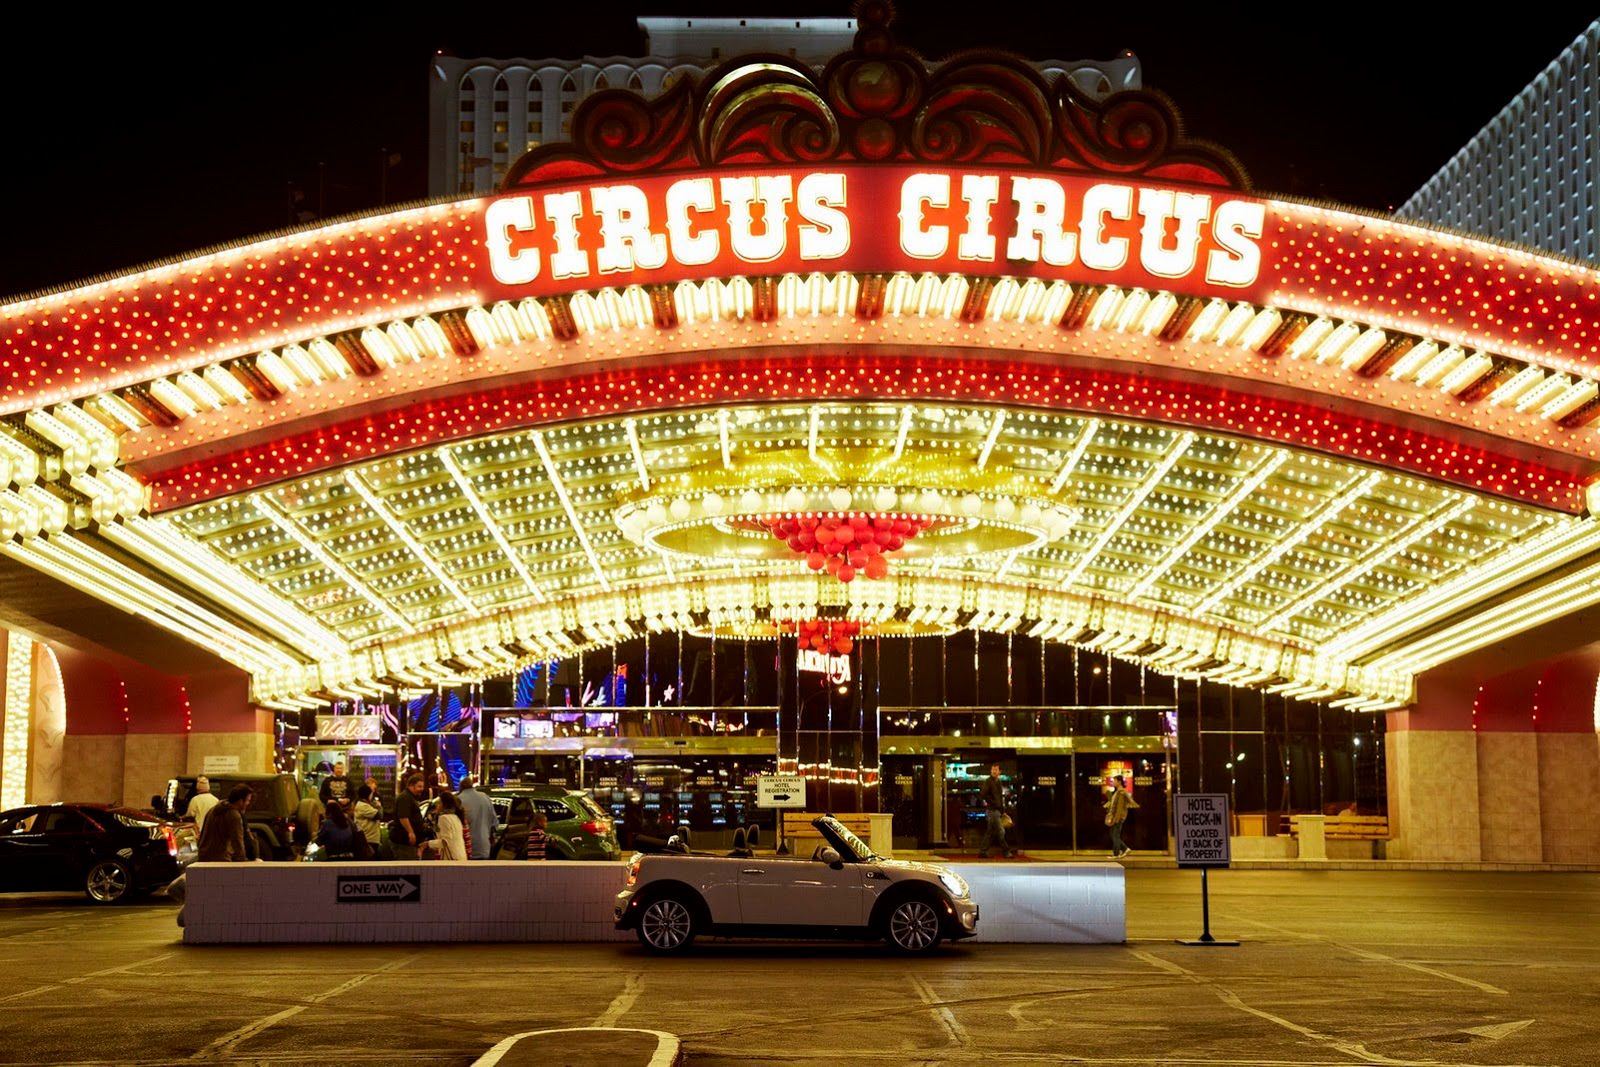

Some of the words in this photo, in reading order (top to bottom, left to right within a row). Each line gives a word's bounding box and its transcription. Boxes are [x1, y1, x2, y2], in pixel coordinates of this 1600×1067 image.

[485, 173, 851, 285] CIRCUS
[898, 173, 1267, 288] CIRCUS
[321, 719, 374, 737] Valet
[1188, 799, 1215, 810] HOTEL
[1182, 813, 1222, 825] CHECK-IN
[1186, 829, 1218, 837] LOCATED
[1183, 839, 1191, 848] AT
[1193, 839, 1212, 848] BACK
[1213, 839, 1223, 848] OF
[1185, 850, 1222, 858] PROPERTY
[342, 883, 371, 894] ONE
[376, 883, 405, 894] WAY
